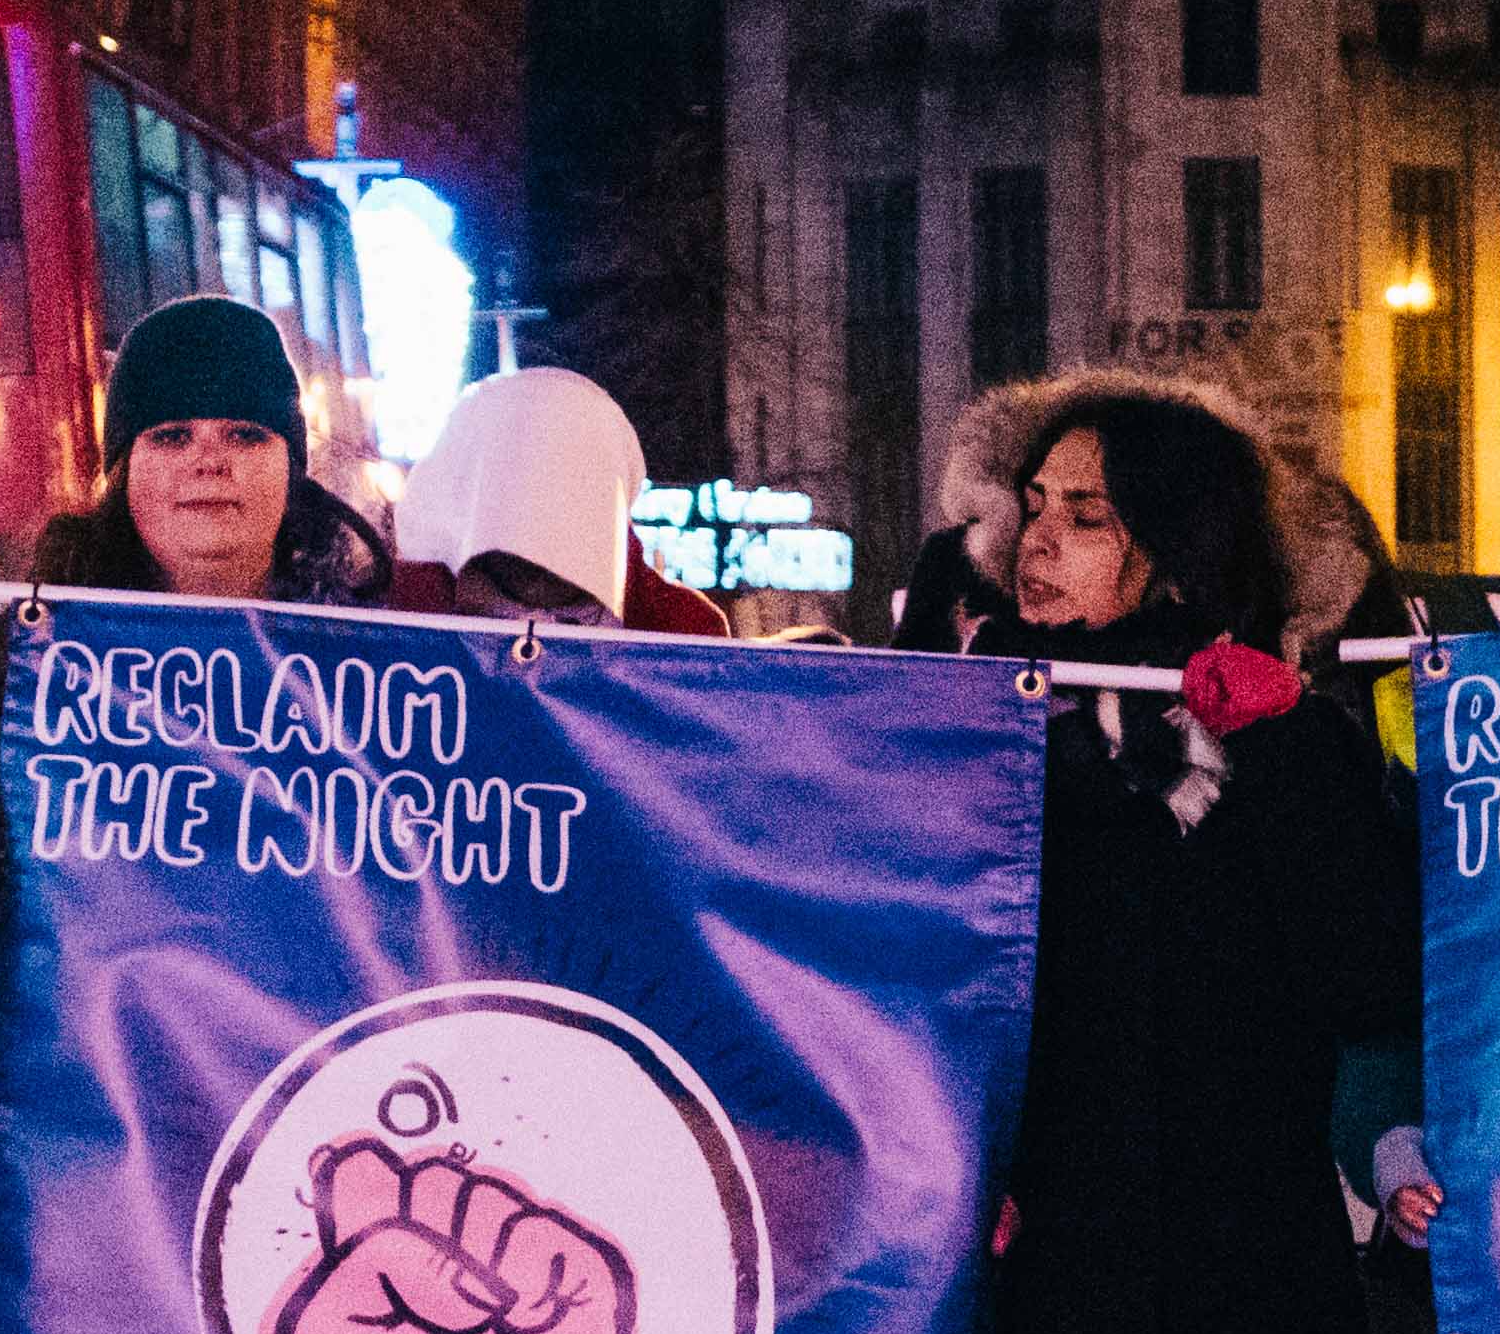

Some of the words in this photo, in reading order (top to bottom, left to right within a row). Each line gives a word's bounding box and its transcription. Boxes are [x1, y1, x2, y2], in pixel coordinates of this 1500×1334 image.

[1107, 317, 1207, 357] FOR
[33, 640, 472, 766] RECLAIM
[26, 753, 218, 868] THE
[236, 765, 588, 895] NIGHT
